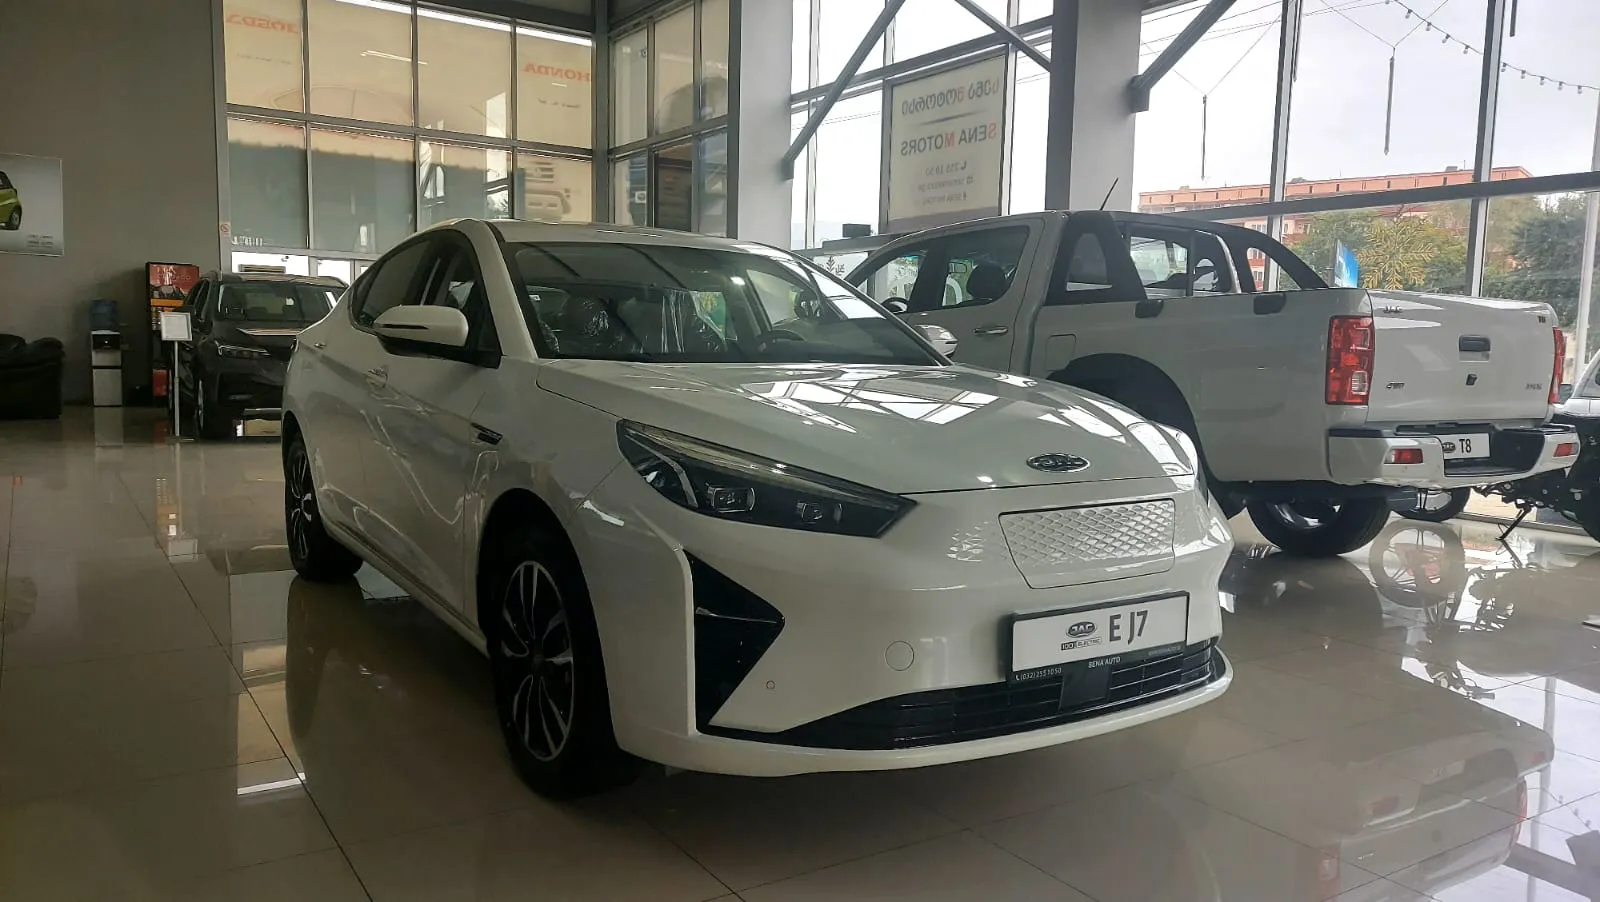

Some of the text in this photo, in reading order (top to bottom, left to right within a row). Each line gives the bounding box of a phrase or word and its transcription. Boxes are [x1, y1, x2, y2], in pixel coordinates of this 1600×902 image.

[1458, 438, 1472, 454] T8
[1069, 623, 1095, 635] JAC
[1109, 609, 1149, 645] E J7
